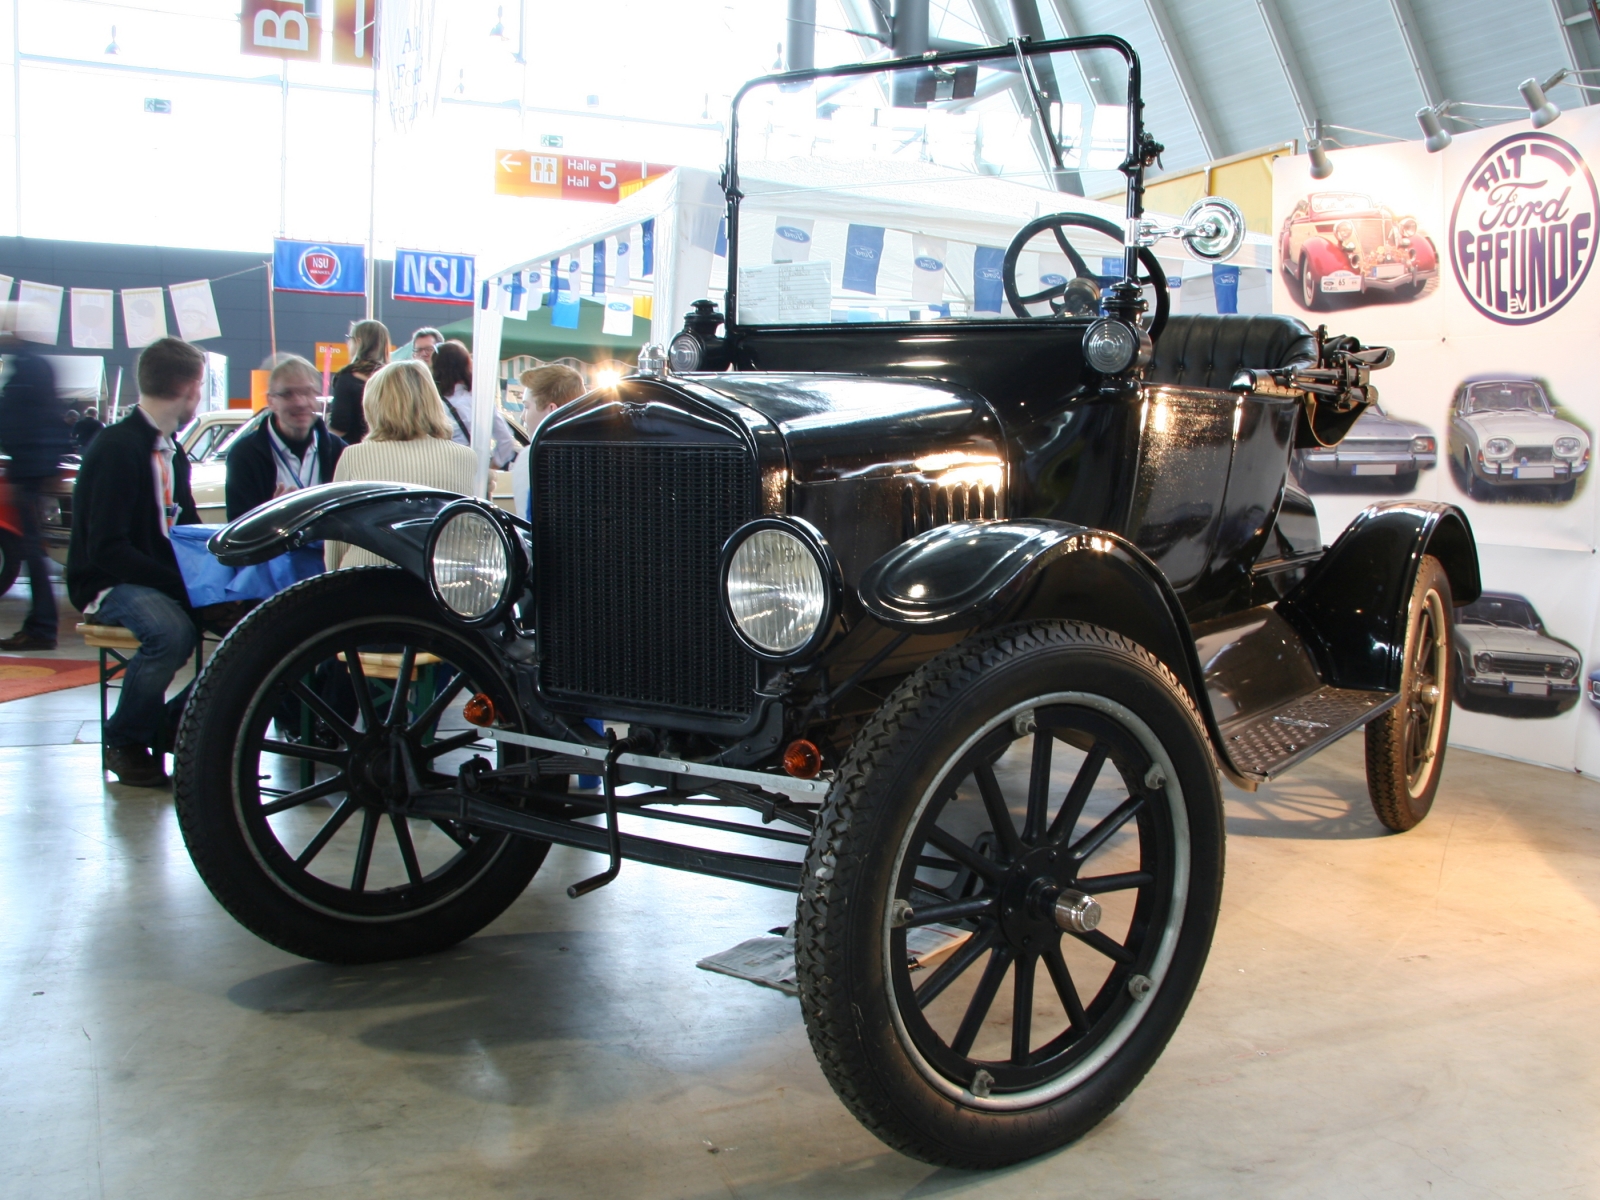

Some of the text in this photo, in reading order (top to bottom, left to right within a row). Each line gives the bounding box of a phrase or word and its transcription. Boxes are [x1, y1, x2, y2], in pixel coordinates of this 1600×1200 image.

[567, 159, 597, 172] Halle
[598, 161, 617, 190] 5
[1472, 143, 1527, 192] ALT
[567, 175, 589, 187] Hall
[1478, 179, 1572, 232] Ford
[312, 256, 329, 269] NSU
[403, 254, 473, 297] NSU
[1457, 212, 1591, 315] FREUNDE
[319, 346, 341, 354] Bitro
